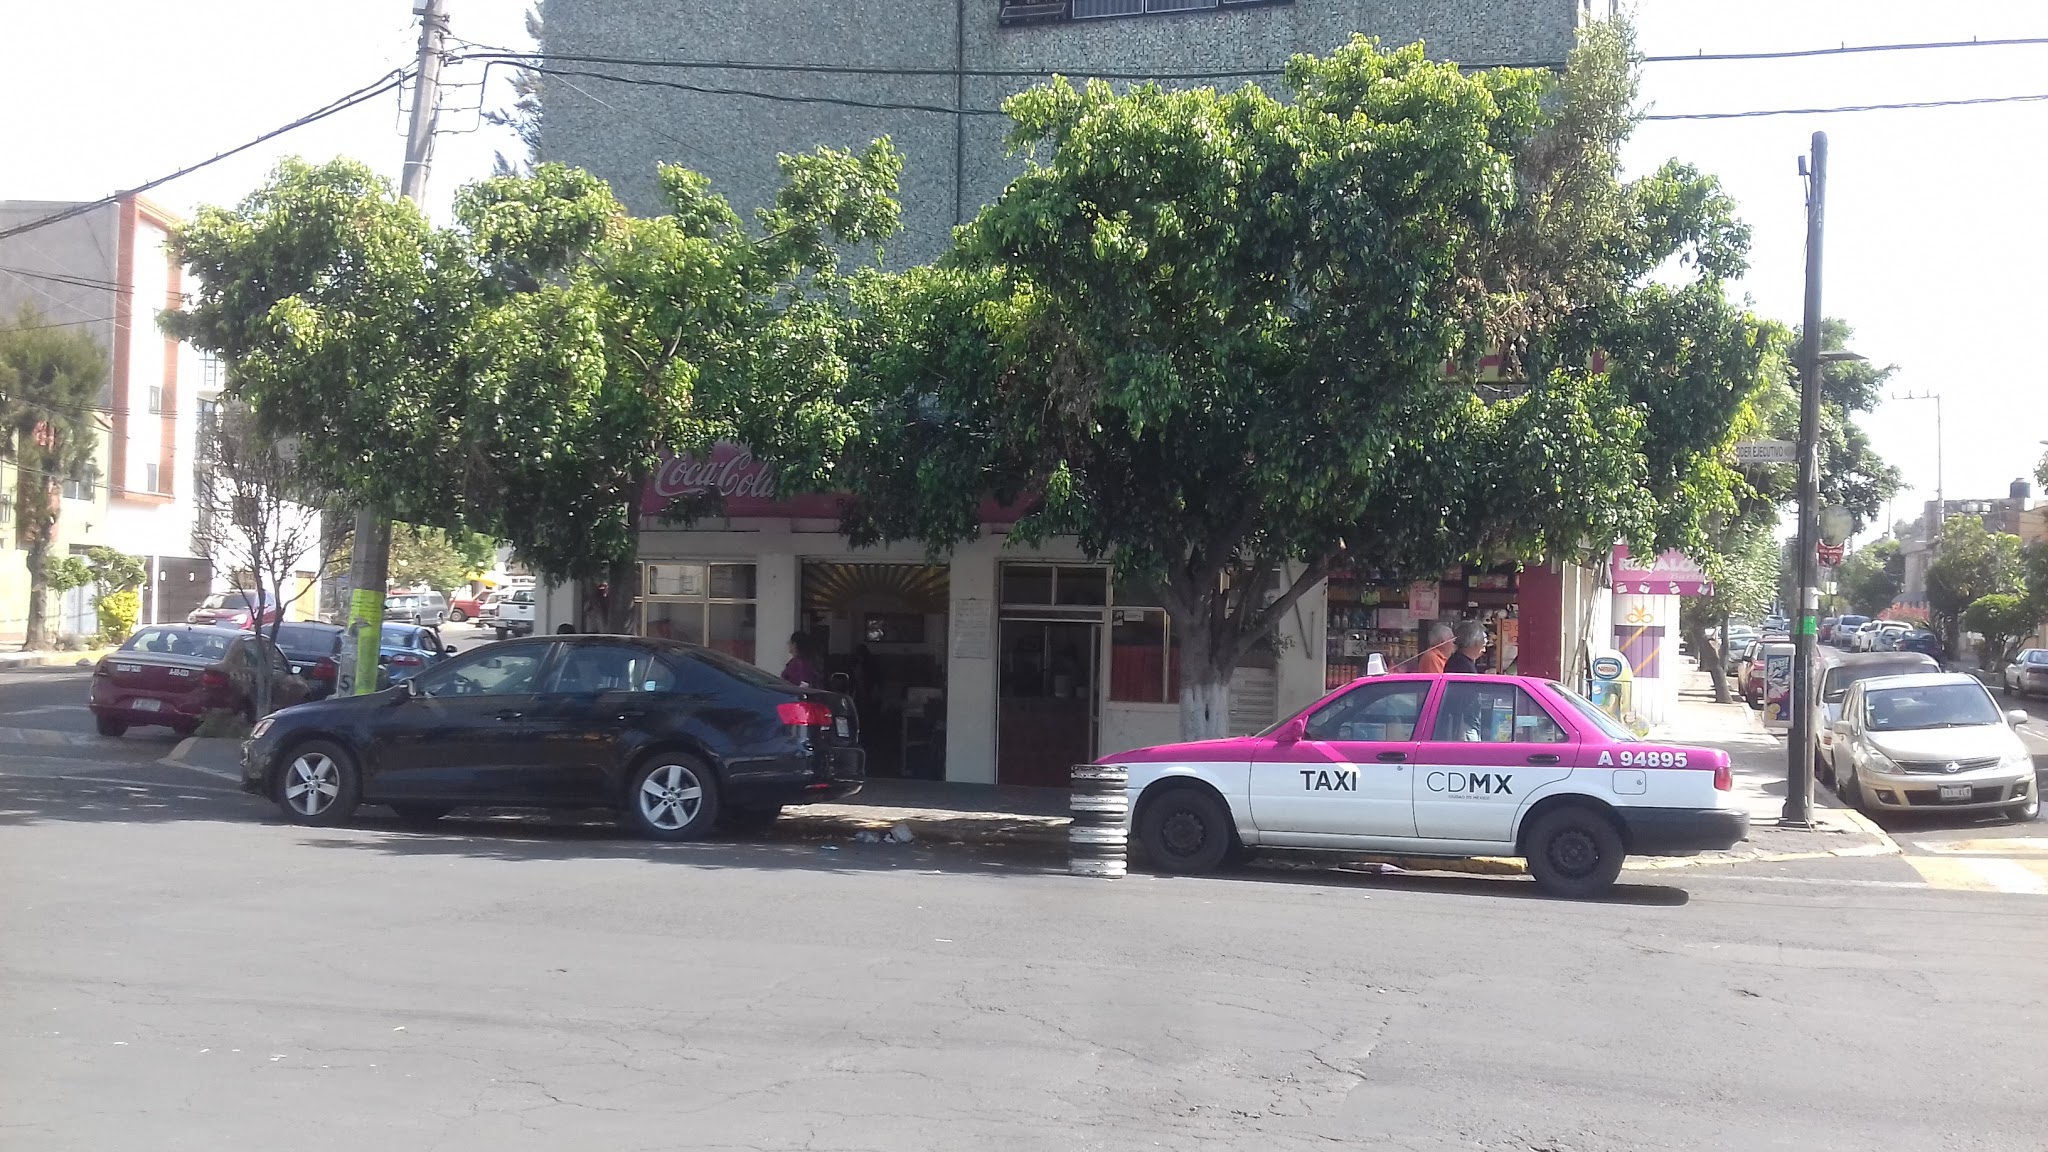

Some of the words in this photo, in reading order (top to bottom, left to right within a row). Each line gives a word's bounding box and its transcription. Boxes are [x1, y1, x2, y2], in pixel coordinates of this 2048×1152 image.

[1737, 446, 1752, 458] ODER
[1753, 446, 1783, 457] EJECUTIVO
[1597, 750, 1614, 766] A
[1619, 750, 1688, 768] 94895
[1299, 770, 1357, 791] TAXI
[1426, 771, 1513, 794] CDMX
